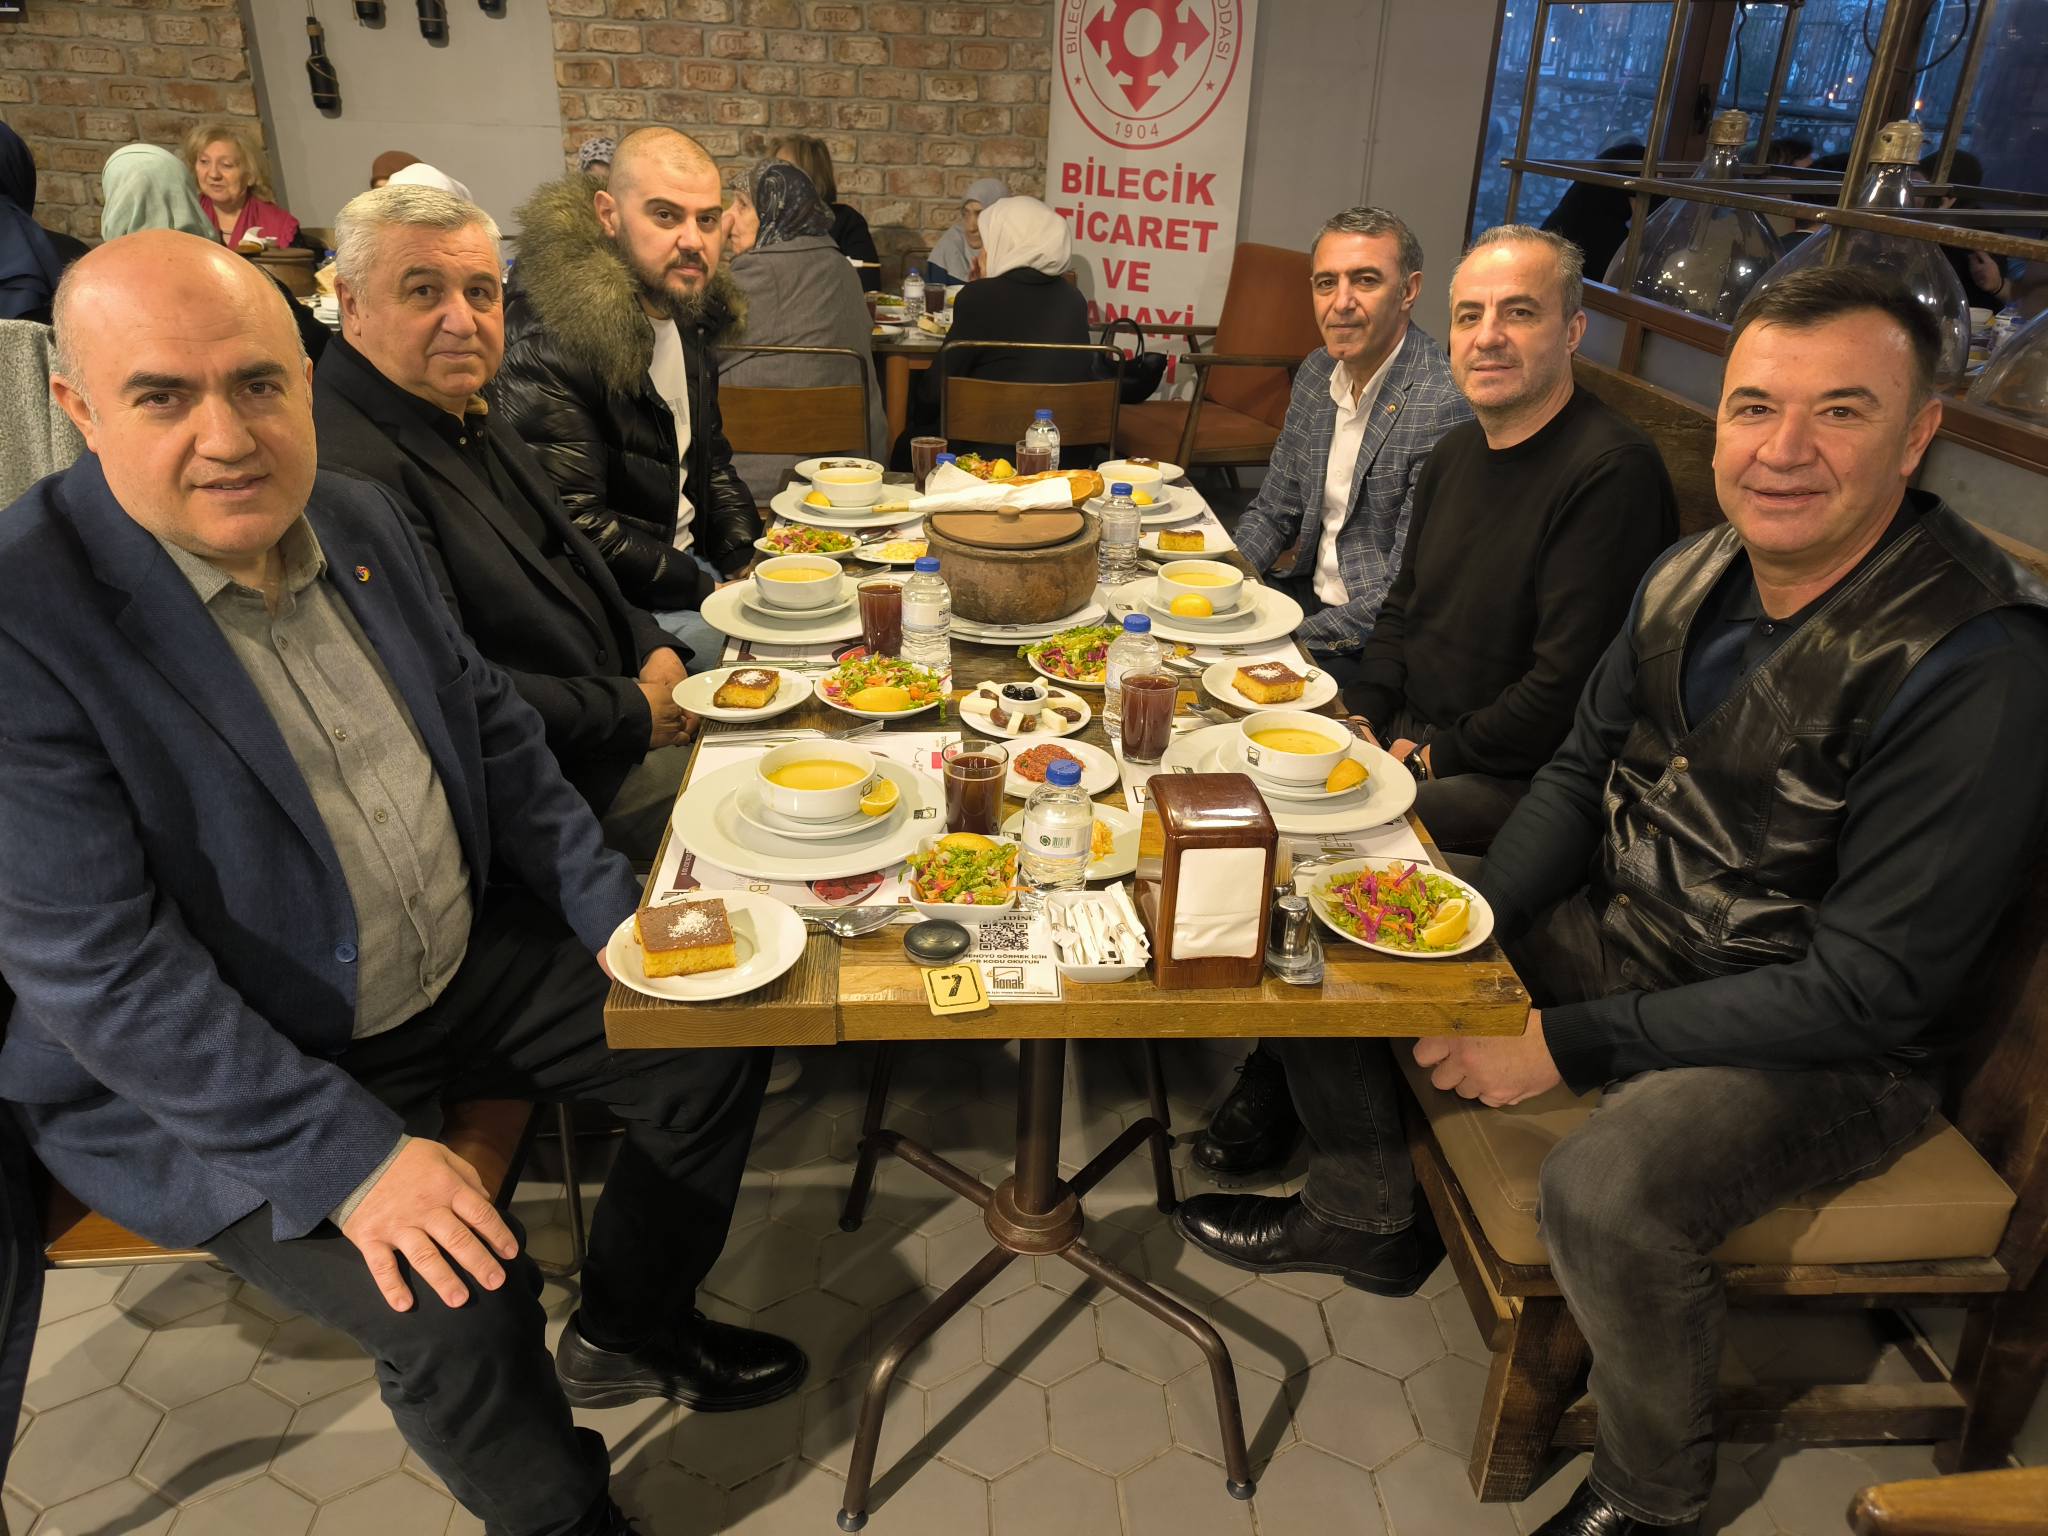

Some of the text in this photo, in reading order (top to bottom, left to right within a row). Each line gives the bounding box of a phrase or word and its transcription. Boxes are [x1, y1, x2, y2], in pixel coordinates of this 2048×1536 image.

[1114, 121, 1160, 139] 1904
[1061, 156, 1217, 206] BİLECİK
[1102, 257, 1151, 293] VE
[1087, 300, 1195, 342] ANAYİ
[941, 973, 963, 998] 7
